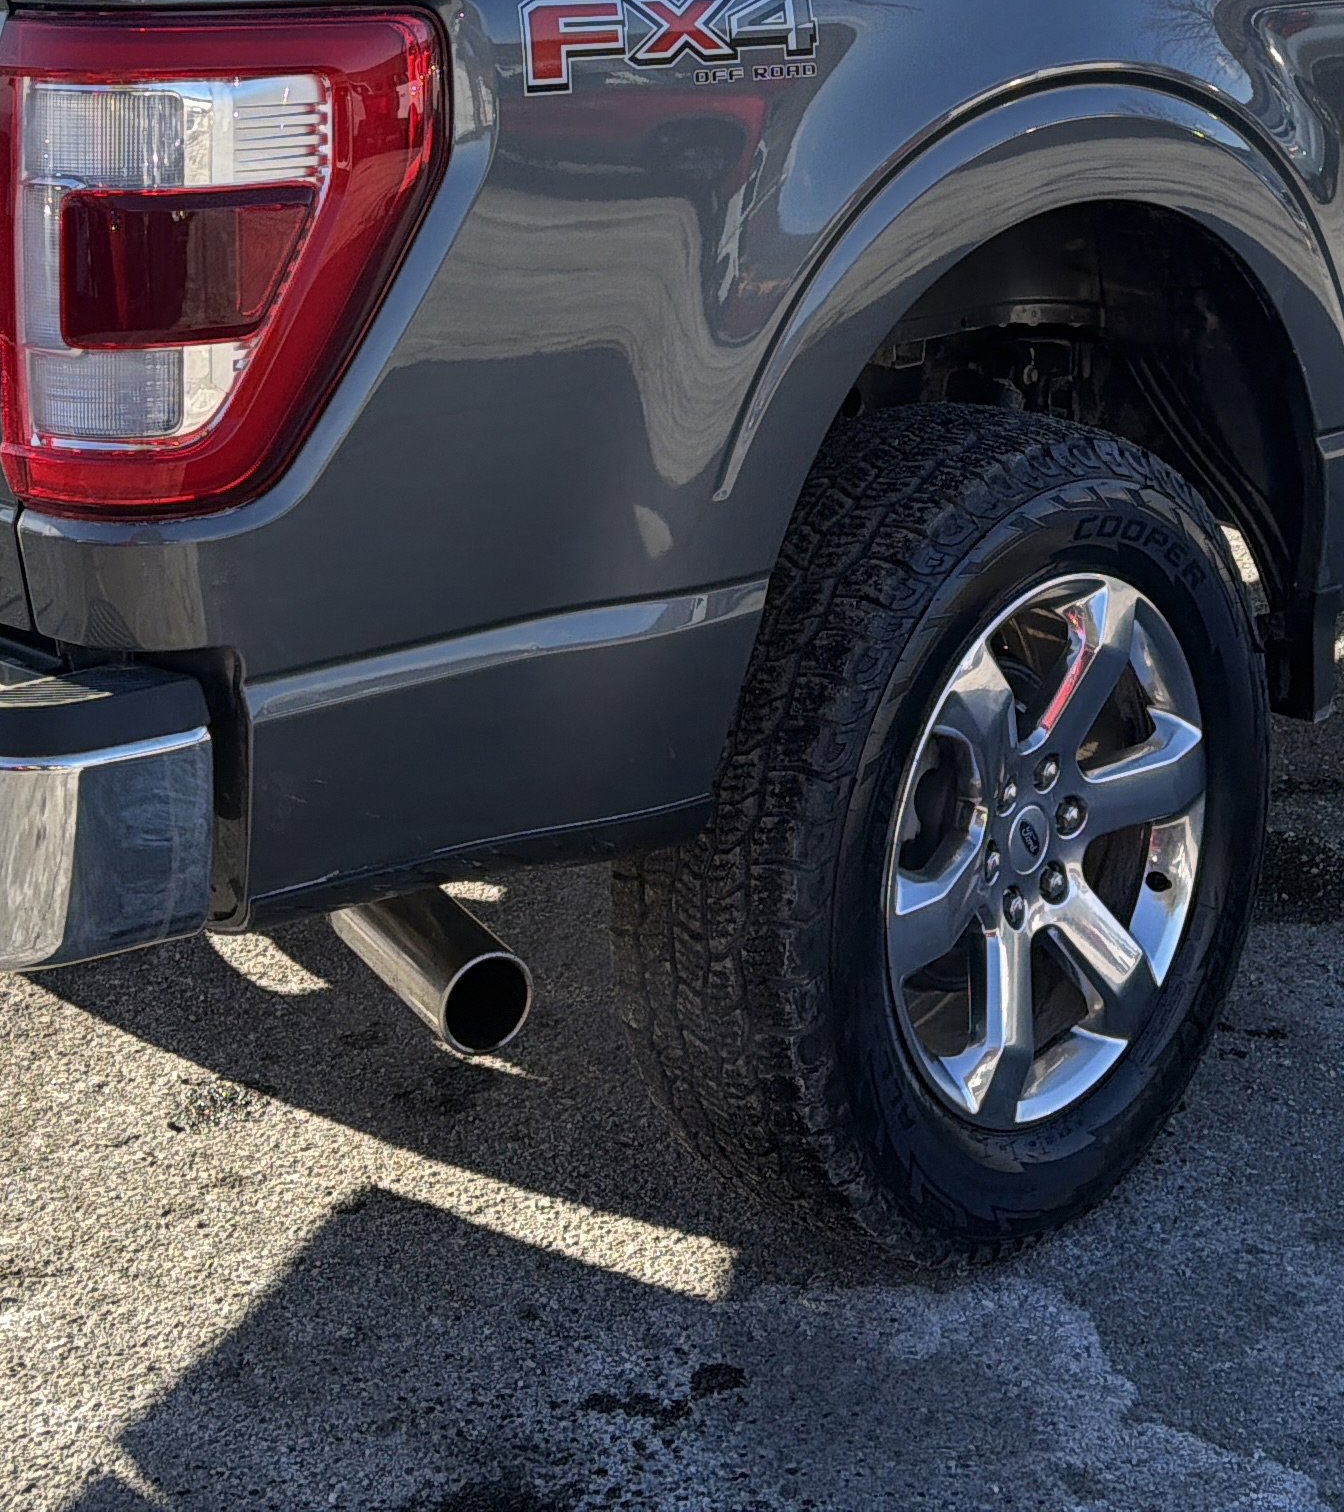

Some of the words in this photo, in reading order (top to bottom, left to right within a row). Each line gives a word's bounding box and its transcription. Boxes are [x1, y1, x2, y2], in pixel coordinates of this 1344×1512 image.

[694, 67, 745, 85] OFF
[752, 62, 817, 81] ROAD
[1073, 514, 1207, 590] COOPER
[1020, 824, 1038, 854] Ford
